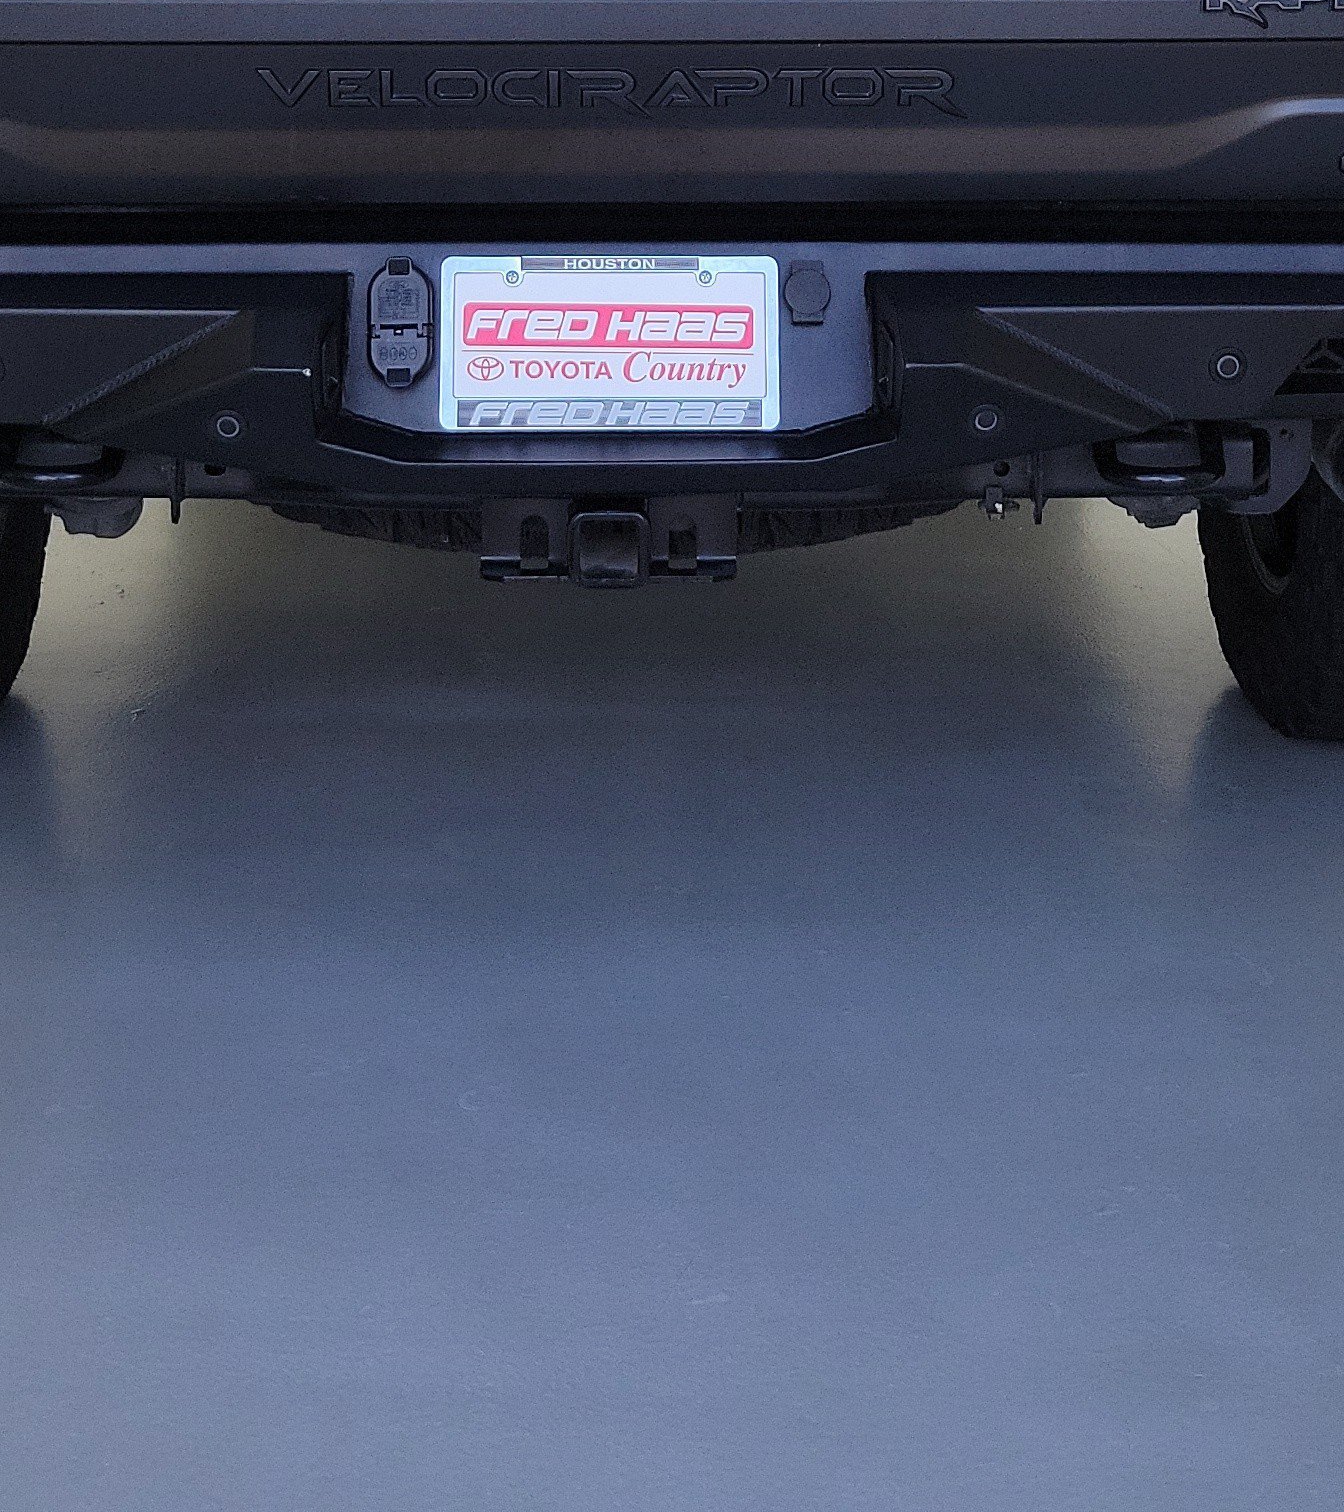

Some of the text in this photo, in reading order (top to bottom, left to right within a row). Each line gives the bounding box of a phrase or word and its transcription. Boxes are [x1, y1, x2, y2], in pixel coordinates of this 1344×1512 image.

[256, 67, 967, 118] VELOCIRAPTOR
[563, 258, 657, 270] HOUSTON
[509, 351, 746, 389] TOYOTA Country
